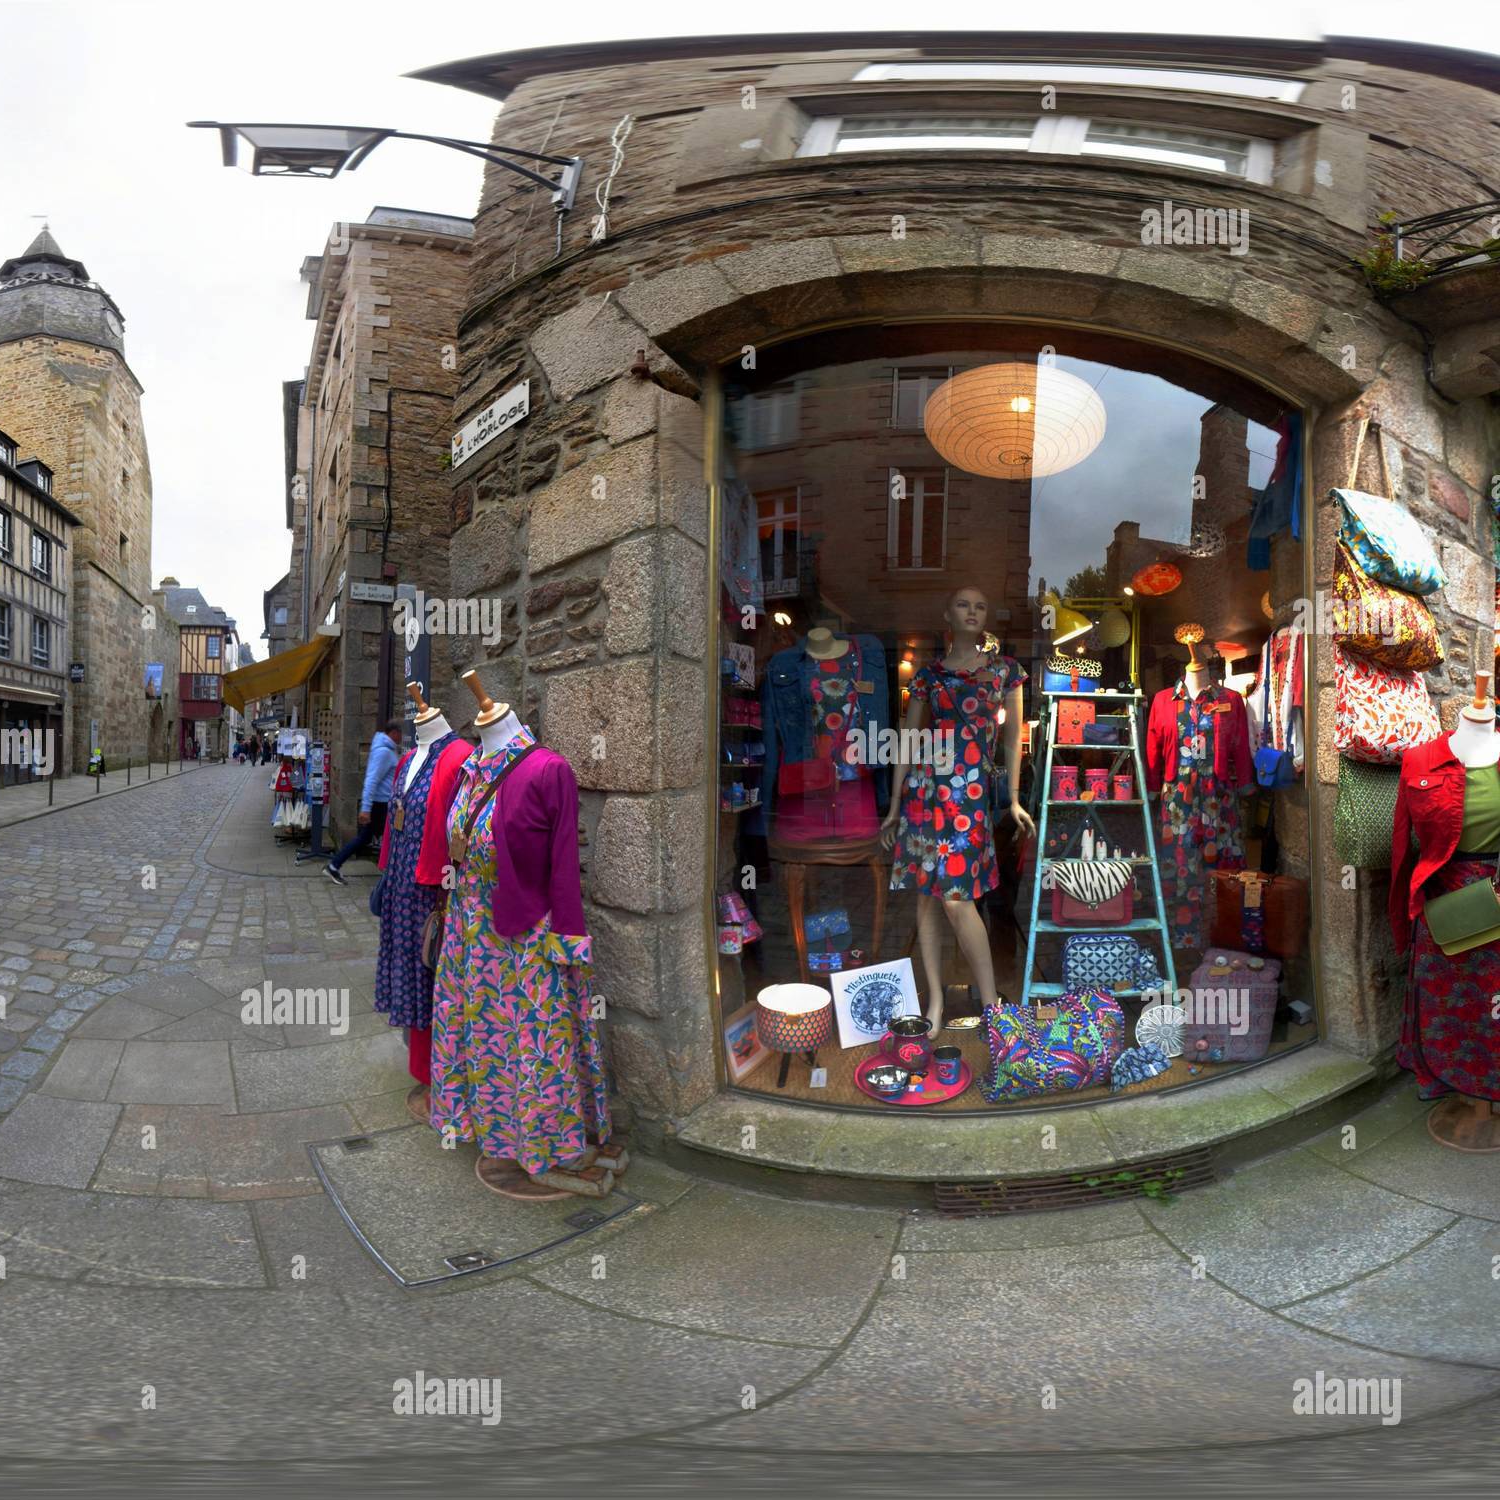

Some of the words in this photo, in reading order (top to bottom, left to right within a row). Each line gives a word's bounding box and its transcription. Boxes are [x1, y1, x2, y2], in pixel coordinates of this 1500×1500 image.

[476, 408, 495, 428] RUE
[453, 447, 464, 463] DE
[467, 400, 525, 452] L'HORLOGE
[843, 971, 902, 995] Mistinguette
